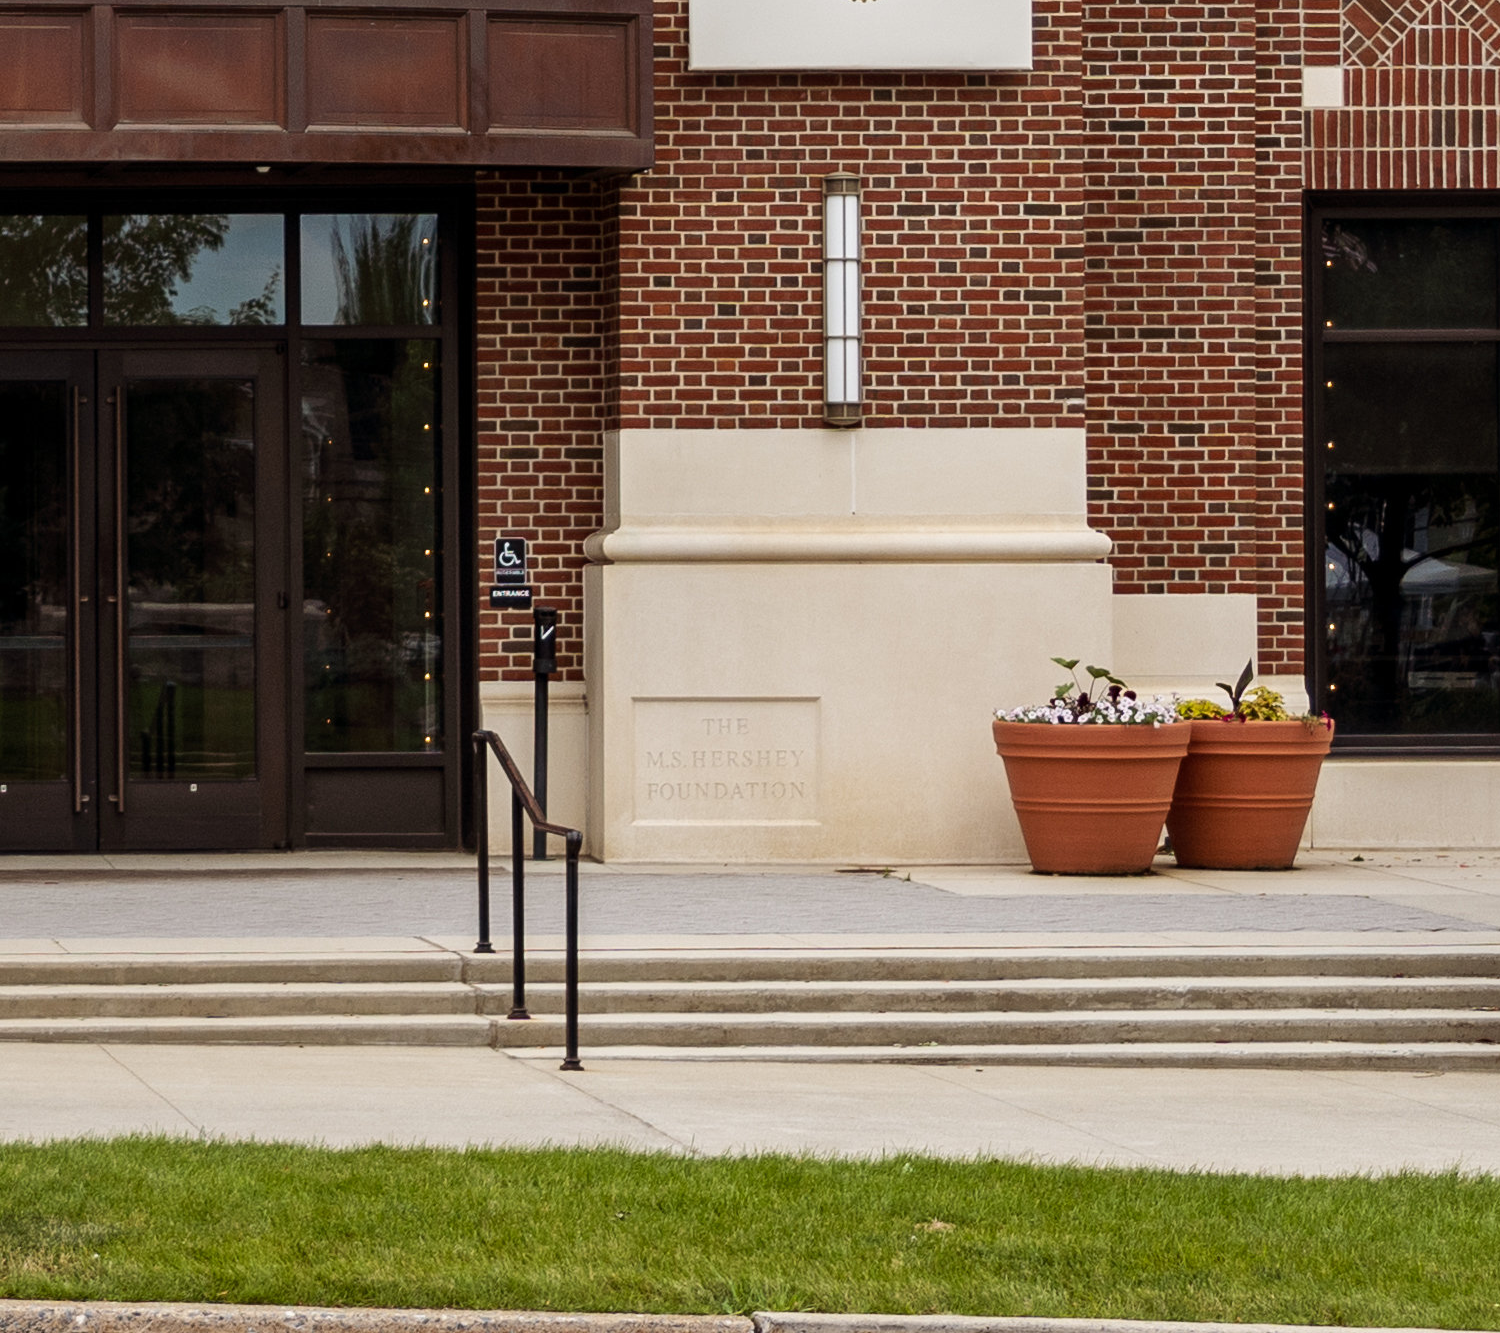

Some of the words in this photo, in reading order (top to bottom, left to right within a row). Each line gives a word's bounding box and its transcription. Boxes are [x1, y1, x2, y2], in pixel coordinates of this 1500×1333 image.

[492, 589, 530, 598] ENTRANCE
[701, 717, 750, 736] THE
[647, 780, 806, 801] FOUNDATION
